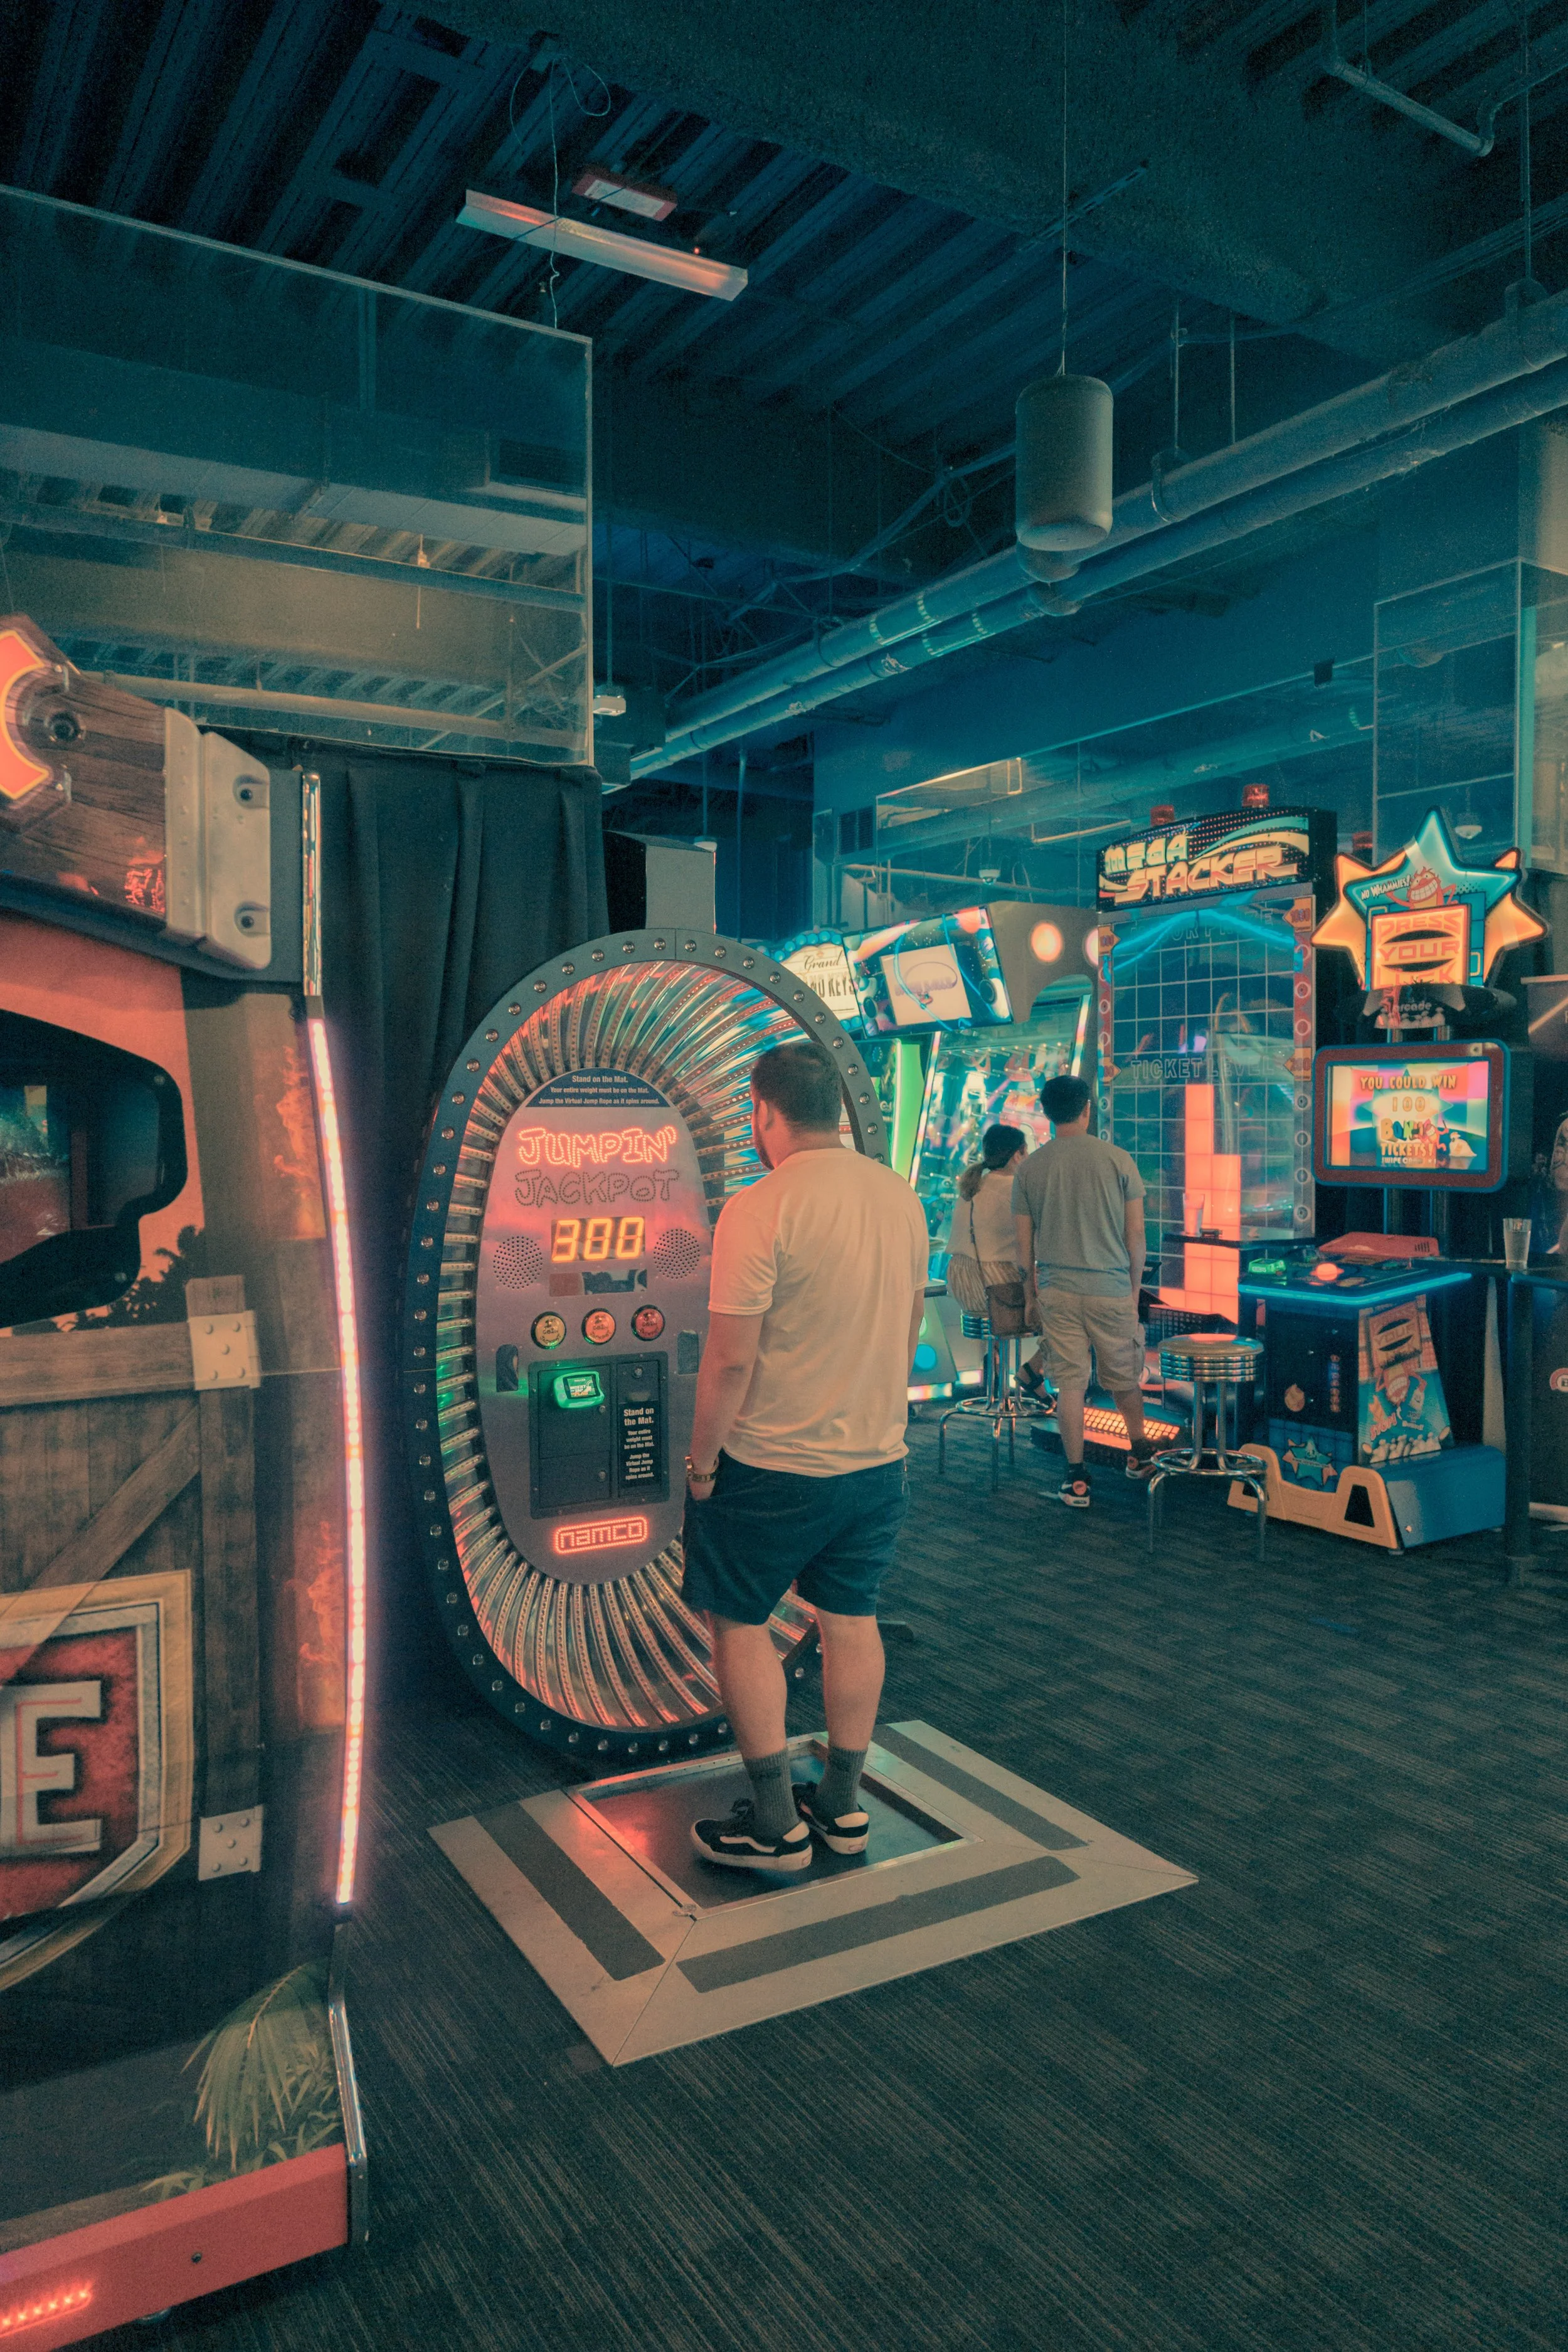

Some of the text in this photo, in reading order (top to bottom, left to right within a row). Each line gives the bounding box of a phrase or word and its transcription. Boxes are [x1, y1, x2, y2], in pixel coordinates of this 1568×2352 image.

[1105, 834, 1187, 874] MEGA
[1115, 846, 1298, 905] STACKER
[1361, 875, 1411, 900] NO WHAMMIES!
[1378, 912, 1461, 942] PRESS
[803, 950, 843, 973] Grand
[1378, 941, 1459, 961] YOUR
[572, 1075, 590, 1083] Stand
[1130, 1057, 1202, 1079] TICKET
[1360, 1074, 1456, 1089] YOU COULD WIN
[1392, 1096, 1425, 1112] 100
[518, 1126, 677, 1168] JUMPIN'
[1381, 1143, 1433, 1157] TICKETS!
[514, 1168, 680, 1208] JACKPOT
[552, 1217, 645, 1263] 300
[623, 1407, 644, 1416] Stand
[638, 1416, 654, 1424] Mat.
[560, 1522, 643, 1549] namco
